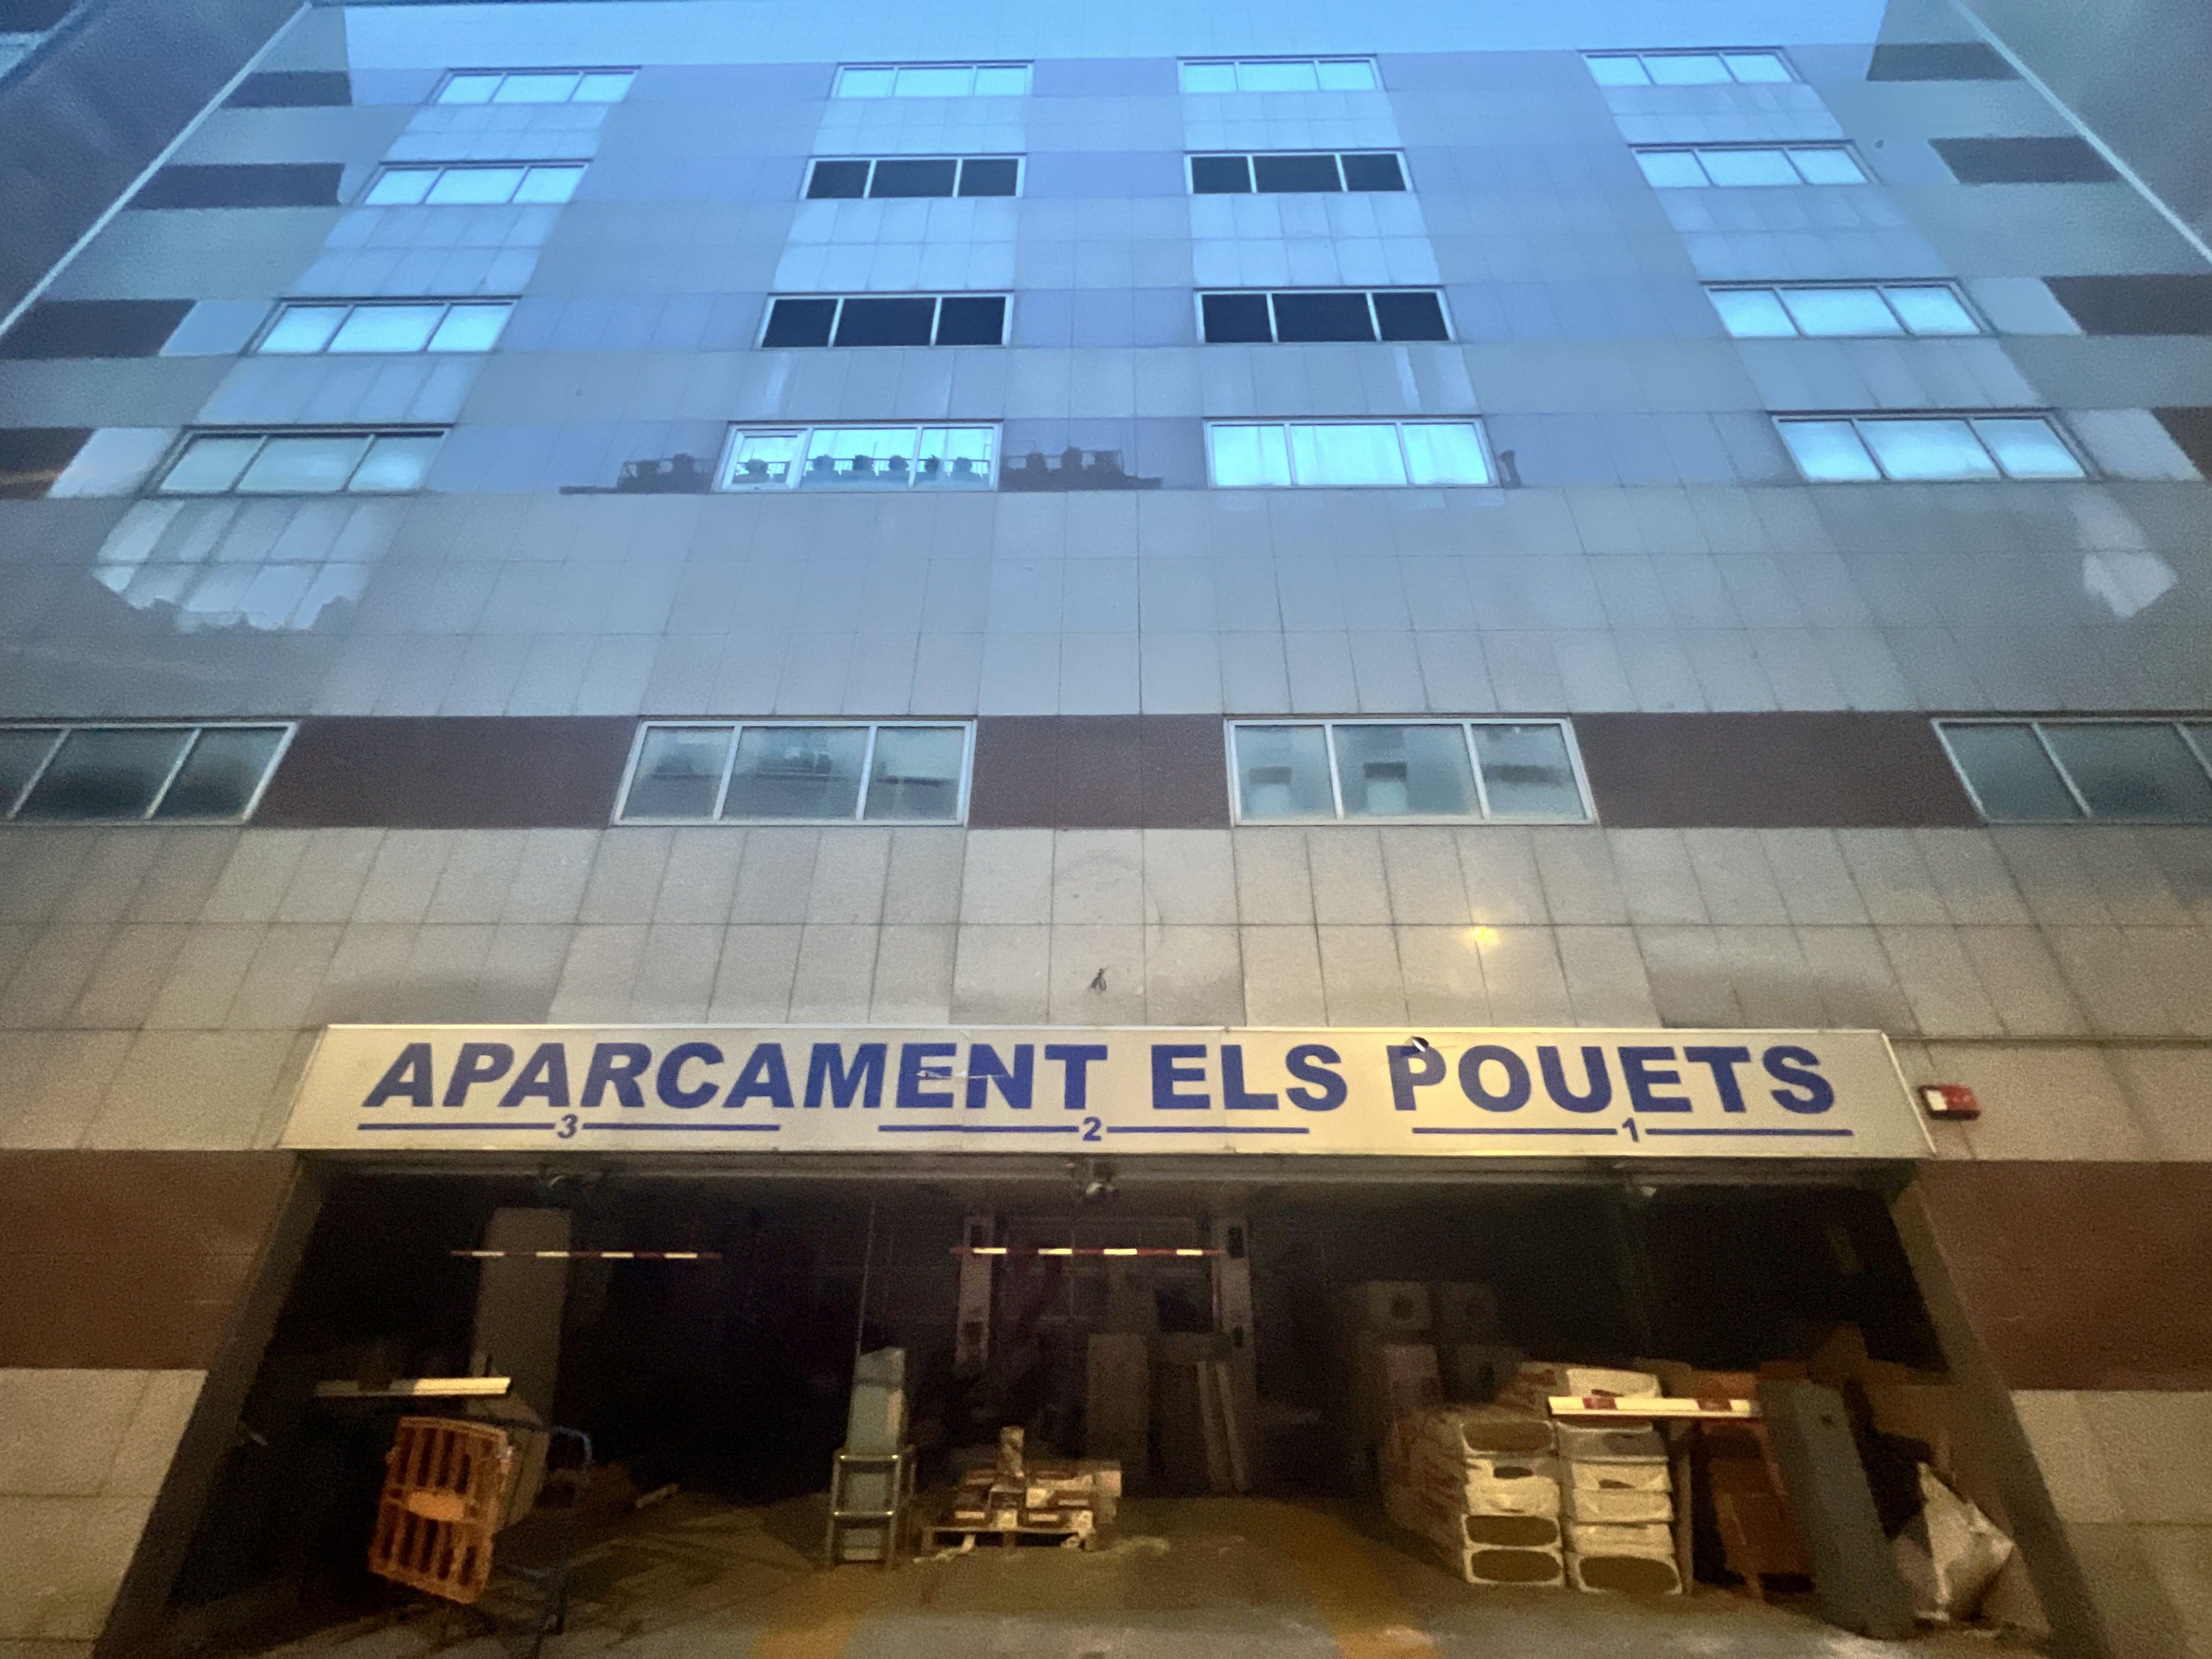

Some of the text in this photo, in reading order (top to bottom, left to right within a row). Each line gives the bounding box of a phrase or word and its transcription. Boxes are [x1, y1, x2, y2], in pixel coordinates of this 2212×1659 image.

[363, 1041, 1835, 1114] APARCAMENT ELS POUETS
[556, 1114, 577, 1138] 3
[1082, 1116, 1102, 1142] 2
[1622, 1118, 1639, 1142] 1
